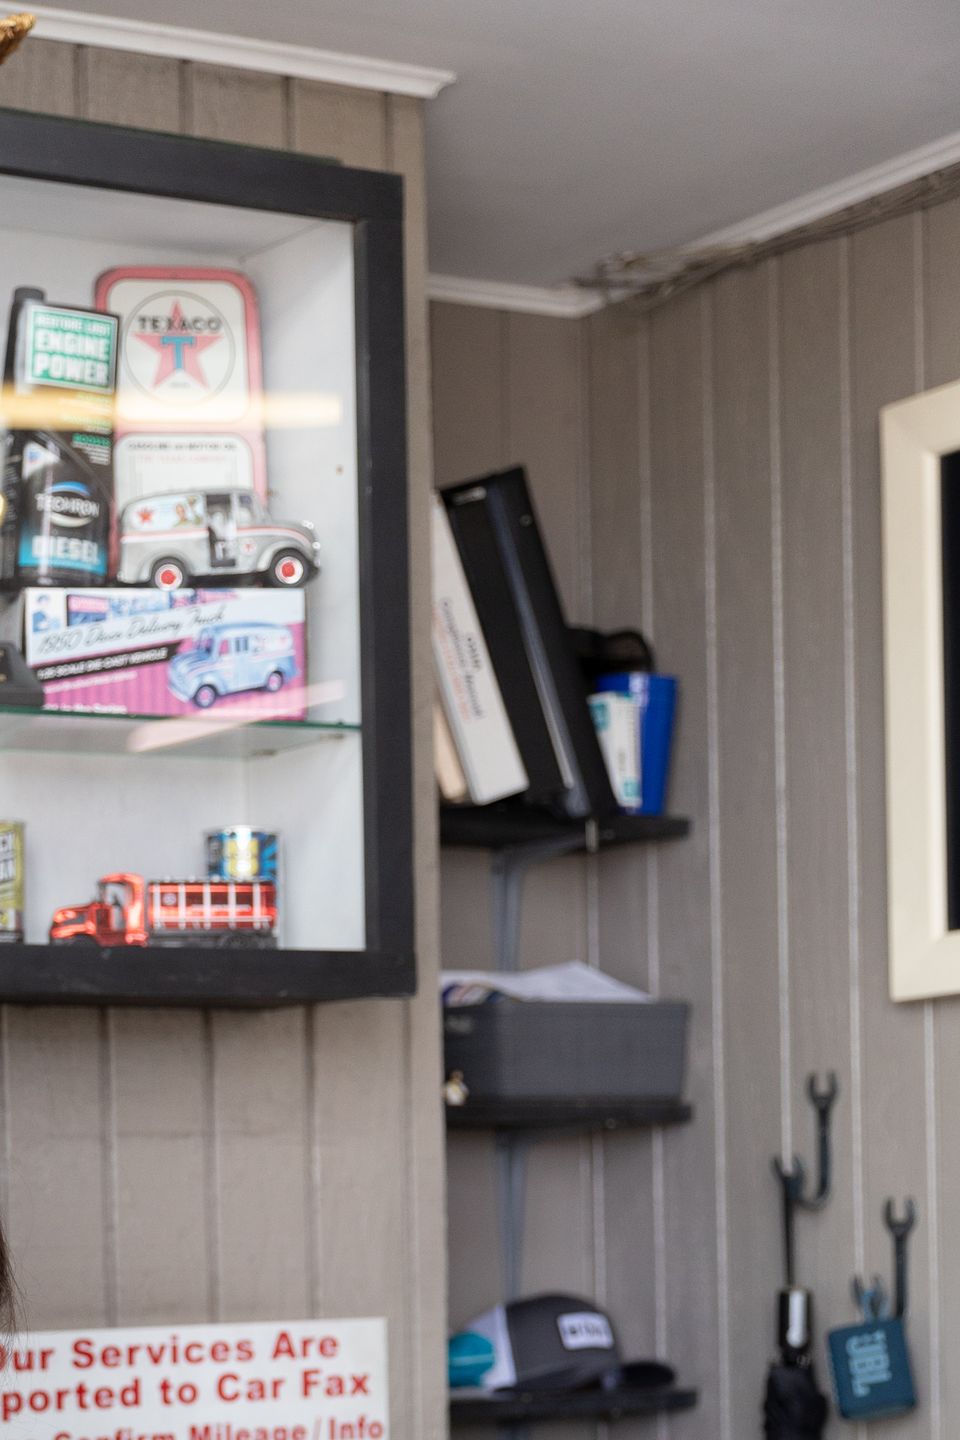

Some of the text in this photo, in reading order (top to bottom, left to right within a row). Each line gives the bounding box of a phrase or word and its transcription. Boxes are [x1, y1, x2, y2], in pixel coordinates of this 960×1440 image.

[138, 316, 223, 331] TEXACO
[34, 329, 111, 361] ENGINE
[34, 352, 109, 387] POWER
[35, 493, 100, 518] TECHRON
[32, 534, 101, 564] DIESEL
[72, 1334, 254, 1369] Services
[272, 1330, 339, 1361] Are
[846, 1329, 893, 1397] JBL
[159, 1378, 200, 1407] to
[217, 1372, 286, 1402] Car
[301, 1368, 370, 1398] Fax
